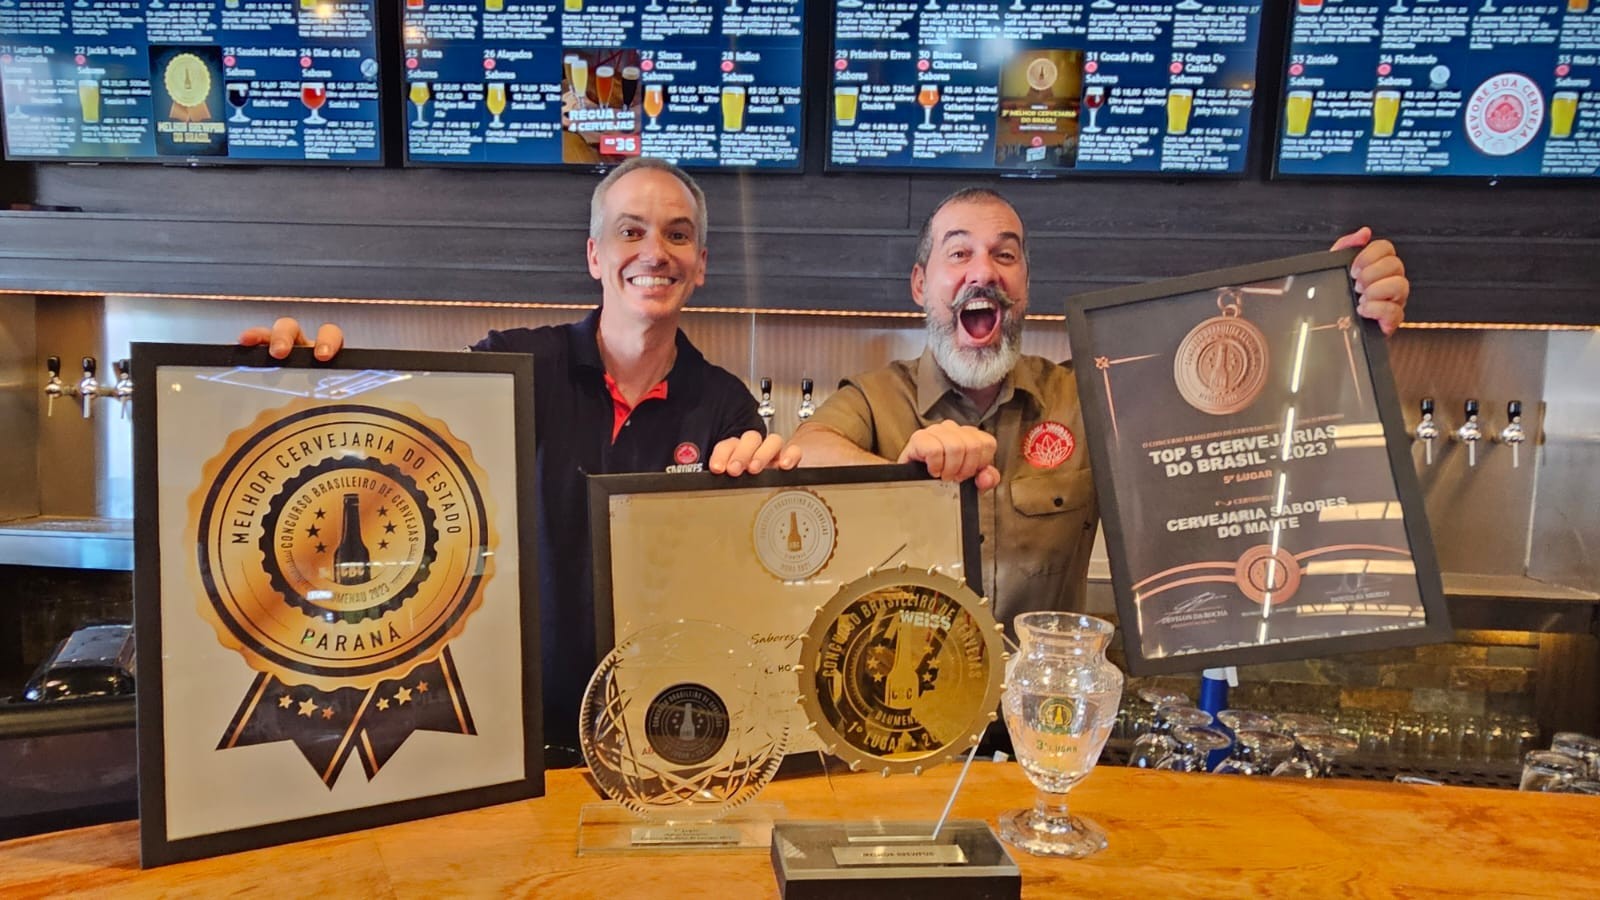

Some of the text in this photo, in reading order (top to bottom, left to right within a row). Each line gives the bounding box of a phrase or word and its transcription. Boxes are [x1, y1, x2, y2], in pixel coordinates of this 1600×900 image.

[237, 48, 268, 57] Saudosa
[270, 48, 297, 57] Maloca
[333, 49, 341, 57] de
[343, 49, 360, 57] Luta
[497, 50, 532, 60] Alagados
[642, 51, 682, 60] 27 Simca
[722, 52, 733, 60] 28
[836, 50, 911, 59] 29 Primeiros Erros
[1087, 52, 1097, 60] 31
[1100, 52, 1128, 61] Cocada
[1171, 54, 1183, 62] 32
[1212, 54, 1225, 62] Do
[656, 61, 696, 70] Chambord
[1185, 64, 1217, 72] Castelo
[226, 68, 256, 76] Sabores
[302, 69, 332, 78] Sabores
[408, 70, 438, 78] Sabores
[485, 71, 516, 79] Sabores
[836, 72, 868, 80] Sabores
[918, 72, 949, 81] Sabores
[722, 74, 754, 82] Sabores
[1085, 75, 1118, 83] Sabores
[1170, 76, 1204, 84] Sabores
[1377, 77, 1412, 86] Sabores
[1470, 78, 1540, 138] DEVORE SUA CERVEJA
[568, 121, 634, 132] 4 CERVEJAS
[616, 138, 636, 151] 36
[1149, 448, 1187, 465] TOP
[1191, 444, 1207, 460] 5
[1166, 462, 1195, 478] DO
[1196, 453, 1266, 475] BRASIL
[1236, 470, 1273, 482] LUGAR
[232, 431, 462, 544] MELHOR CERVEJARIA DO ESTADO
[281, 476, 419, 549] CONCURSO BRASILEIRO DE CERVEJAS
[1166, 508, 1266, 532] CERVEJARIA
[1270, 496, 1348, 517] SABORES
[1218, 525, 1242, 539] DO
[368, 582, 390, 600] 2023
[862, 594, 936, 618] BRASILEIRO
[940, 606, 956, 618] DE
[900, 609, 952, 630] WEISS
[301, 622, 402, 652] PARANÁ
